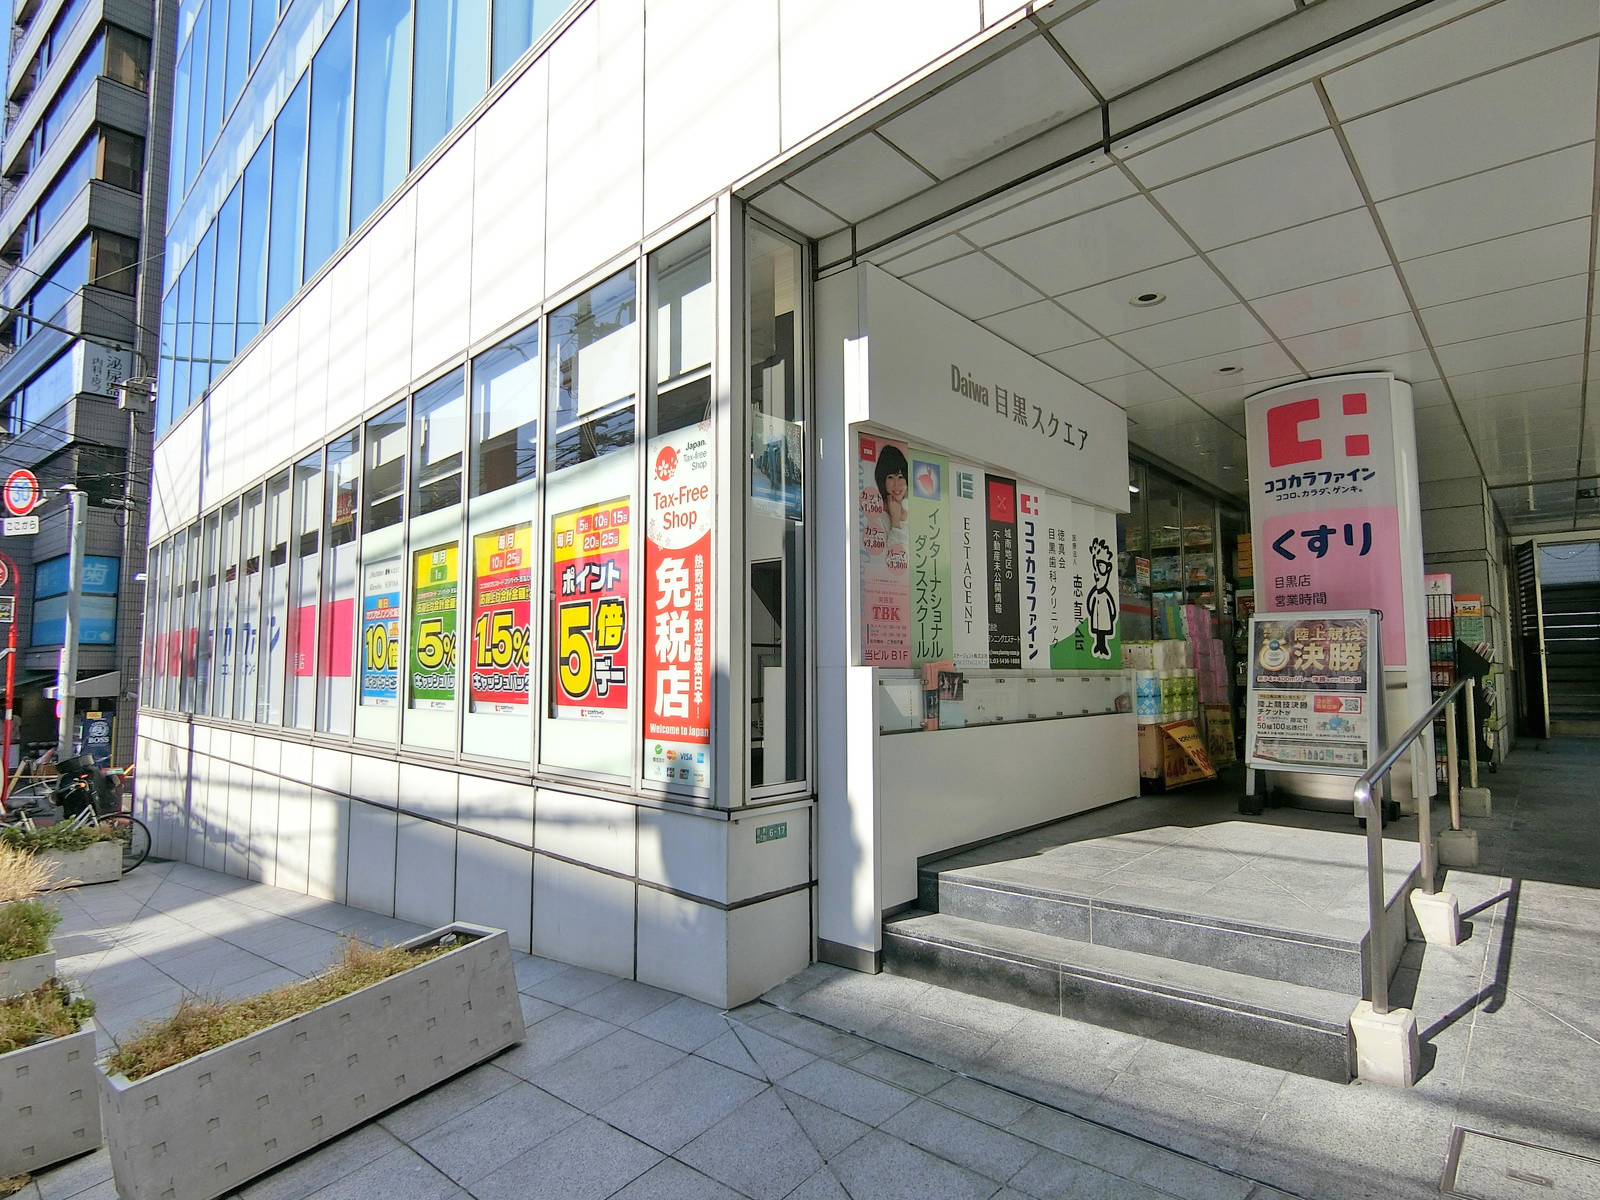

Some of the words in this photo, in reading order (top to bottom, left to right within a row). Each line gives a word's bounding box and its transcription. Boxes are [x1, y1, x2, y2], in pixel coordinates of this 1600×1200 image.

[951, 363, 989, 407] Daiwa
[995, 384, 1088, 451] 目黒スクエア
[684, 450, 707, 463] Tax-free
[692, 460, 707, 471] Shop
[1264, 468, 1376, 494] ココカラファイン
[653, 485, 708, 510] Tax-Free
[861, 490, 882, 500] カット
[1276, 484, 1363, 502] ココロ、カラダ、ゲンキ。
[594, 515, 608, 528] 10日
[612, 510, 628, 524] 15日
[663, 510, 698, 530] Shop
[6, 520, 36, 532] ここから
[865, 527, 885, 536] カラー
[584, 536, 600, 550] 20日
[602, 532, 620, 546] 25日
[1272, 522, 1372, 560] くすり
[562, 559, 622, 596] ポイント
[928, 508, 944, 658] インターナショナル
[963, 517, 973, 634] ESTAGENT
[1275, 574, 1312, 589] 目黒店
[915, 534, 930, 658] ダンススクール
[1024, 520, 1038, 660] ココカラファイン
[1275, 592, 1327, 608] 営業時間
[872, 606, 900, 621] TBK
[654, 557, 692, 719] 免税店
[1294, 627, 1361, 640] 陸上競技
[559, 600, 593, 698] 5
[864, 650, 889, 660] 当ビル
[892, 650, 908, 660] B1F
[1294, 642, 1362, 670] 決勝
[650, 723, 680, 735] Welcome
[680, 726, 688, 736] to
[689, 726, 709, 738] Japan
[680, 752, 693, 761] VISA
[770, 826, 785, 837] 6-17
